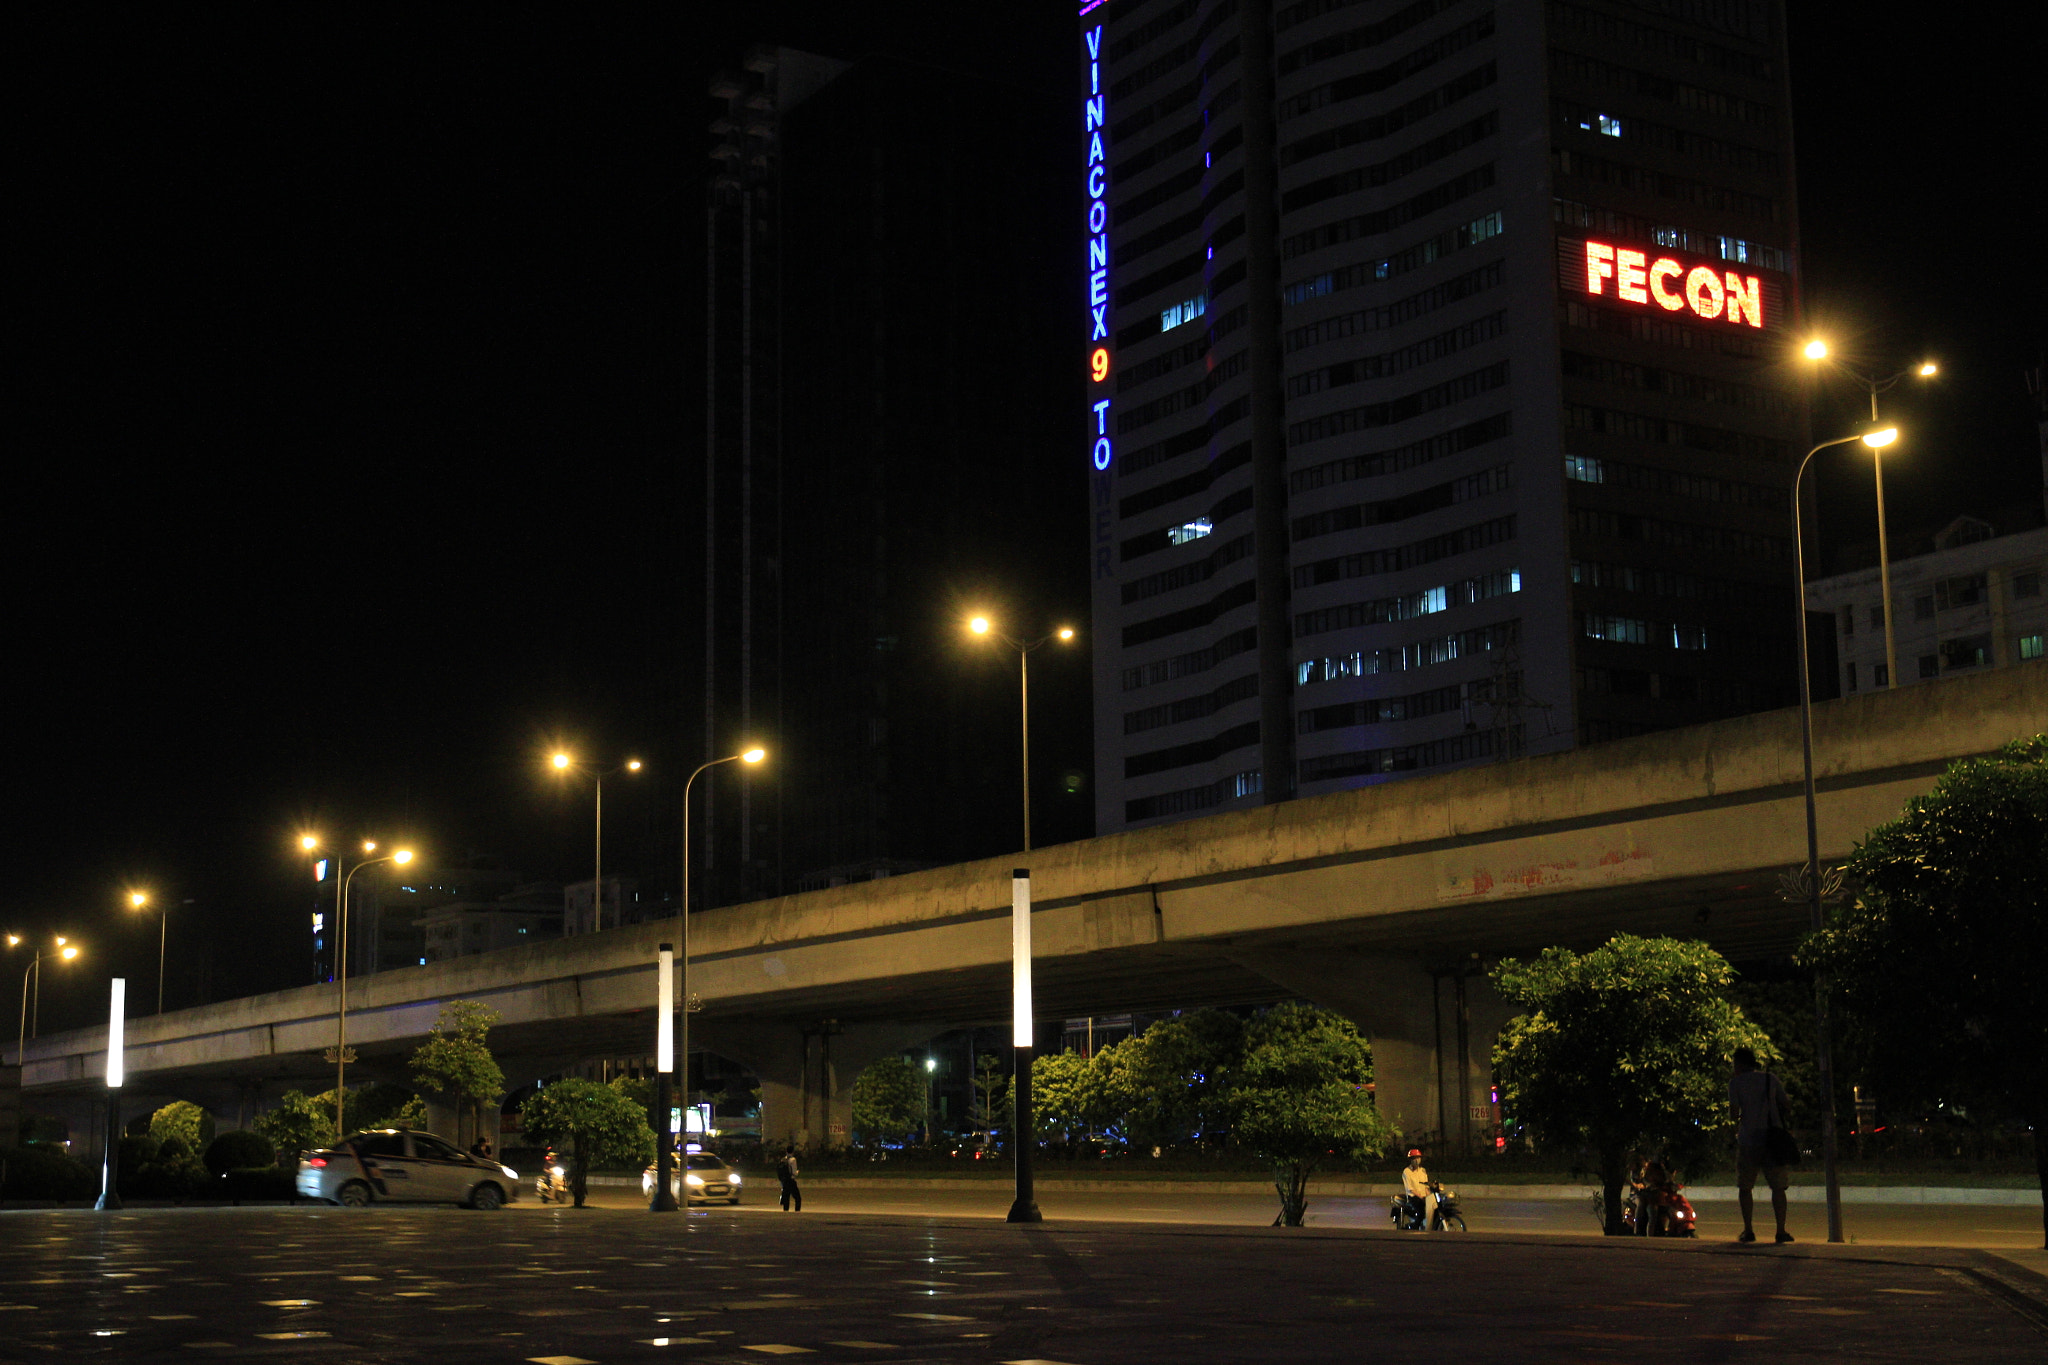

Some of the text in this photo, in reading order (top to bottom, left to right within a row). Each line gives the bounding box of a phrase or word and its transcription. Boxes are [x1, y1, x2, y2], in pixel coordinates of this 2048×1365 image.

[1086, 25, 1108, 341] VINACONEX
[1586, 240, 1763, 329] FECON
[1091, 347, 1109, 383] 9
